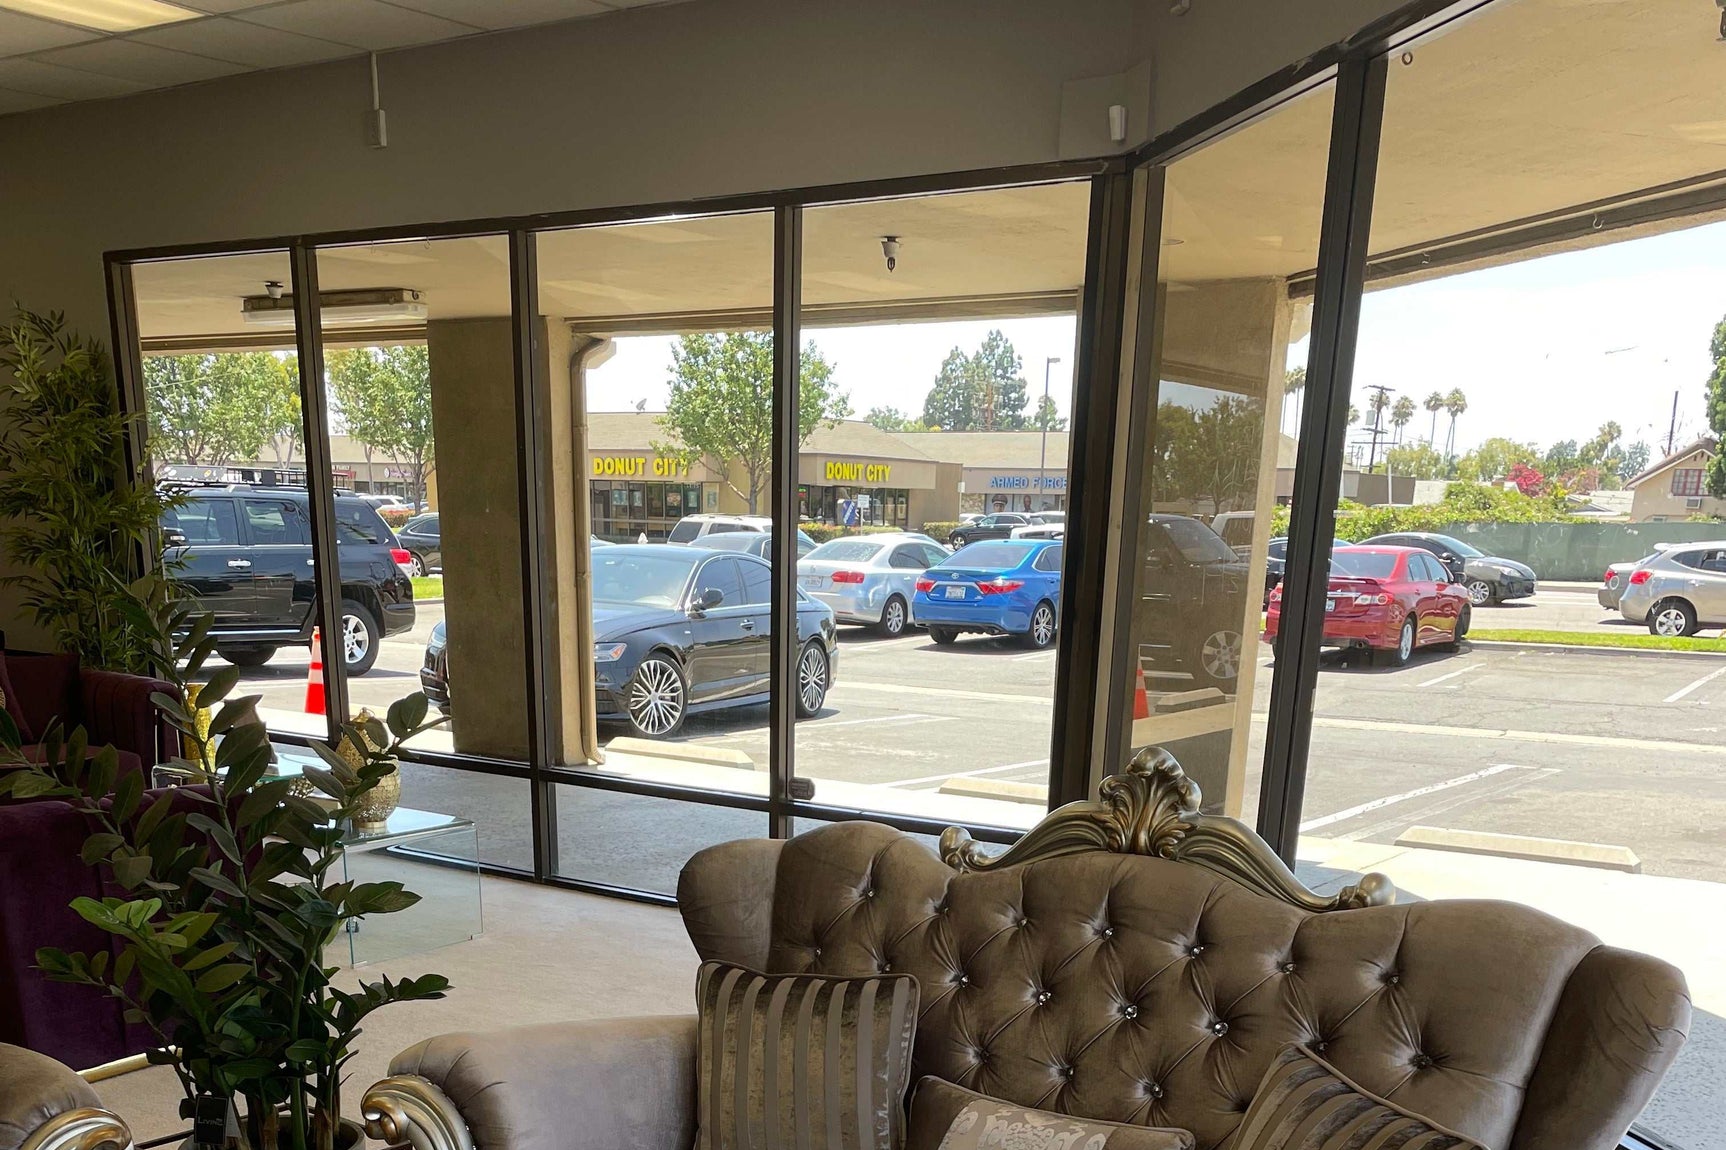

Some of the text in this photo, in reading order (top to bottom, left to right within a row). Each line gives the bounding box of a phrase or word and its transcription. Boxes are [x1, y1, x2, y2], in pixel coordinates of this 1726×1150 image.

[593, 457, 689, 477] DONUT CITY
[826, 461, 891, 481] DONUT CITY
[990, 477, 1029, 488] ARMED
